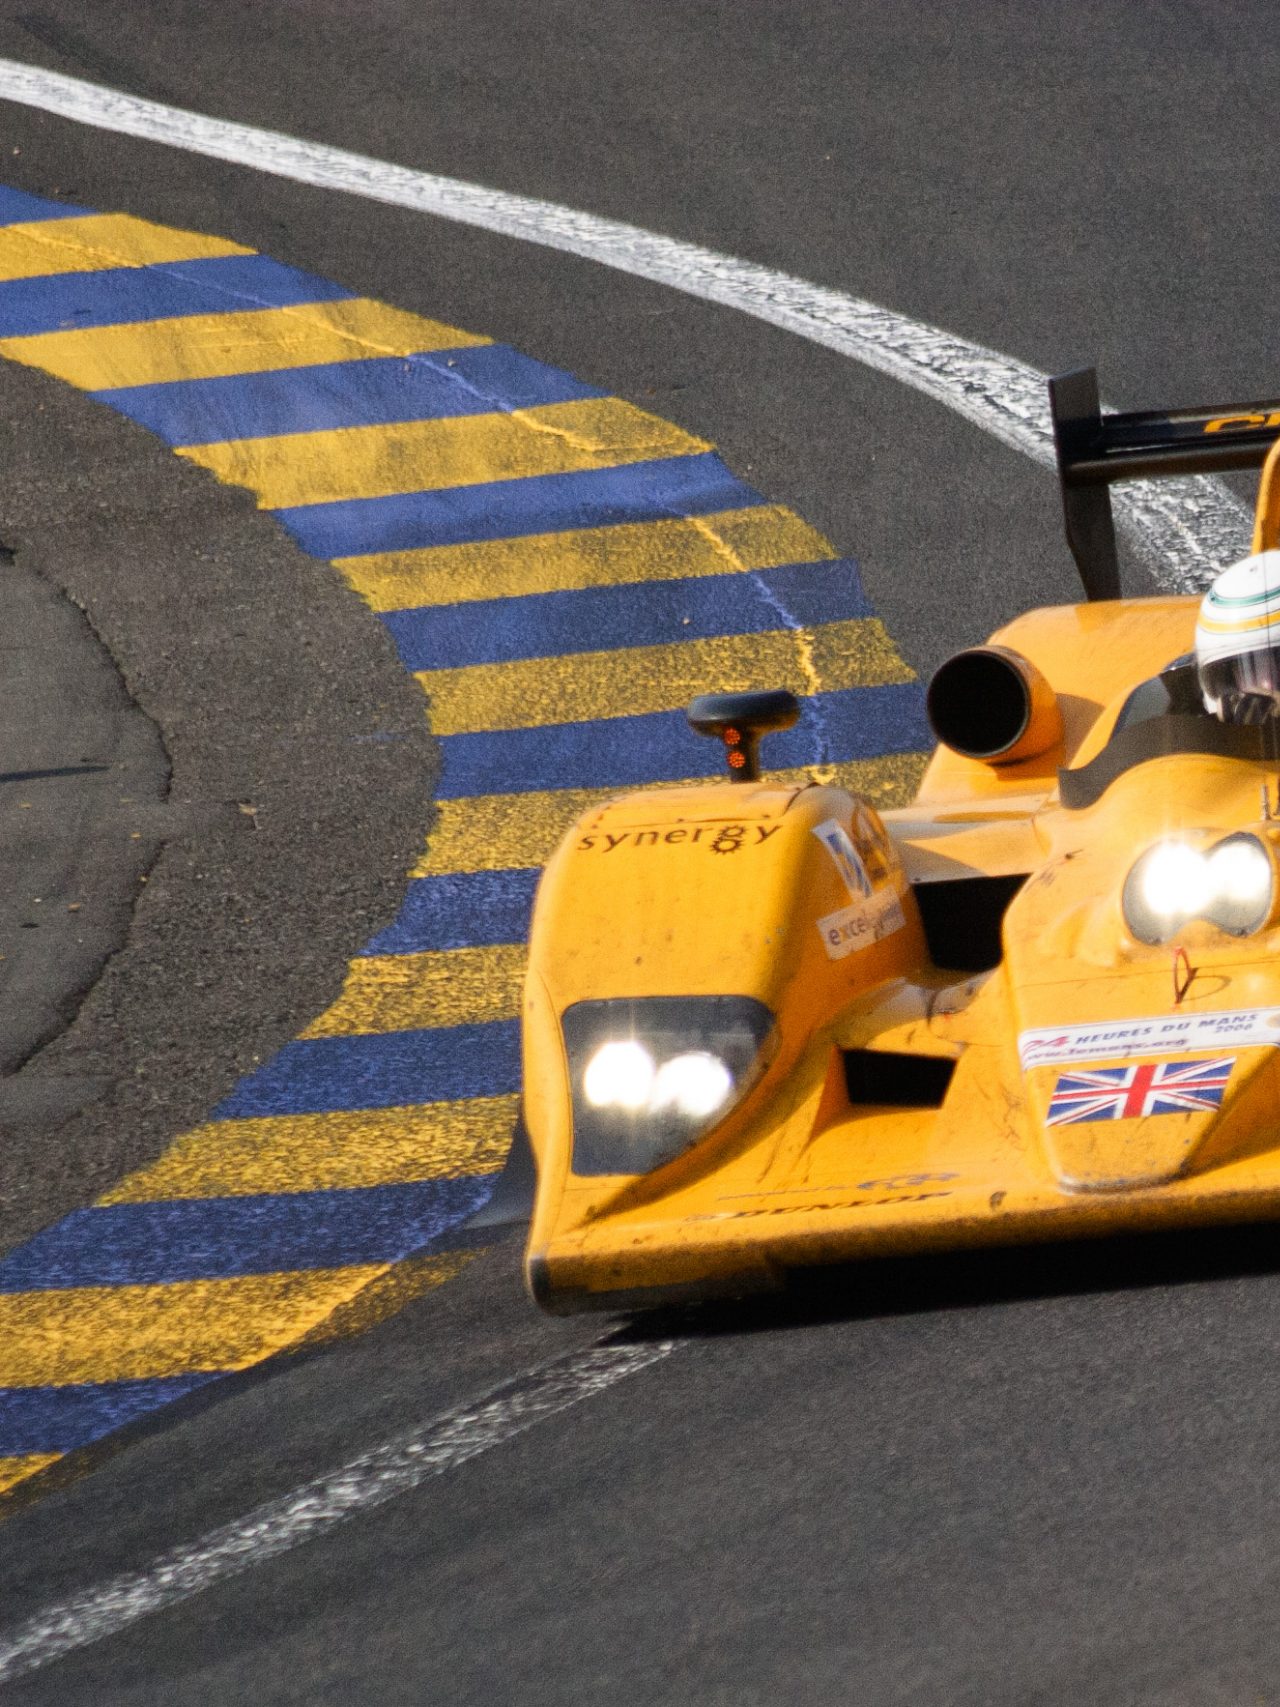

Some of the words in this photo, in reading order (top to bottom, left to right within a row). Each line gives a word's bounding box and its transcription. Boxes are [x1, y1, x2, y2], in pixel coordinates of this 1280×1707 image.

[576, 823, 784, 856] synergy
[1075, 1026, 1153, 1045] HEURES
[1160, 1021, 1191, 1033] DU
[1197, 1013, 1259, 1029] MANS
[1214, 1023, 1254, 1034] 2006
[728, 1191, 953, 1220] DUNLOP
